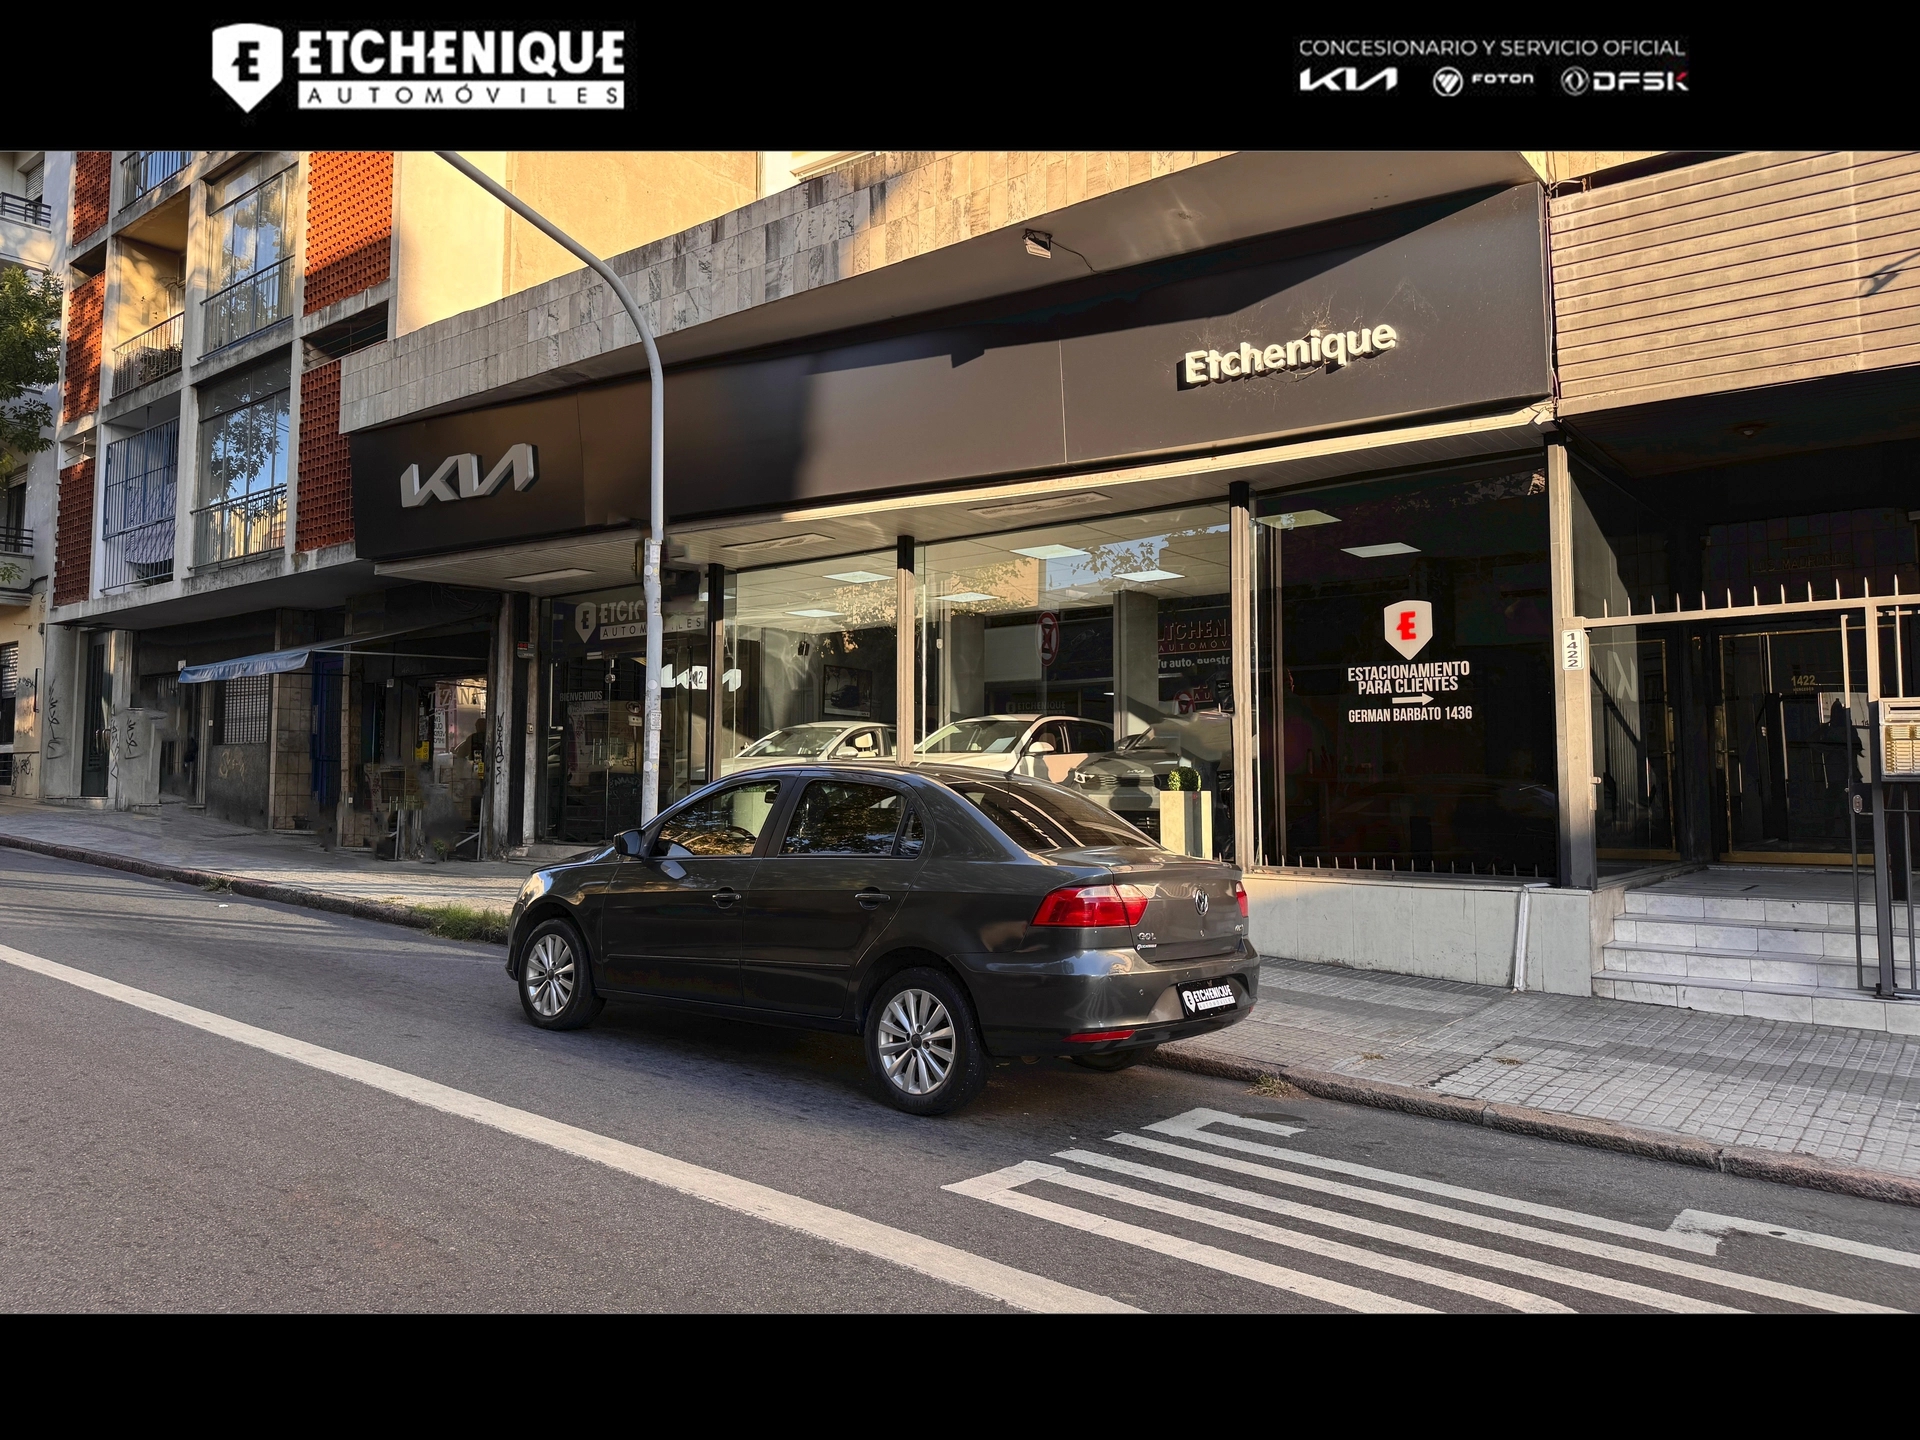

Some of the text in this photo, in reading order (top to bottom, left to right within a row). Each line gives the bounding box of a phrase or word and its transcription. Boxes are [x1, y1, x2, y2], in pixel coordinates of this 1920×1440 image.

[1185, 323, 1398, 384] Etchenique
[400, 443, 535, 508] KIA
[1566, 632, 1579, 668] 1422
[1347, 660, 1470, 682] ESTACIONAMIENTO
[1791, 674, 1816, 686] 1422
[1358, 676, 1458, 695] PARA CLIENTES
[559, 691, 603, 701] BIENVENIDOS
[1348, 705, 1473, 723] GERMAN BARBATO 1436
[1192, 984, 1233, 1003] ETCHENIQUE
